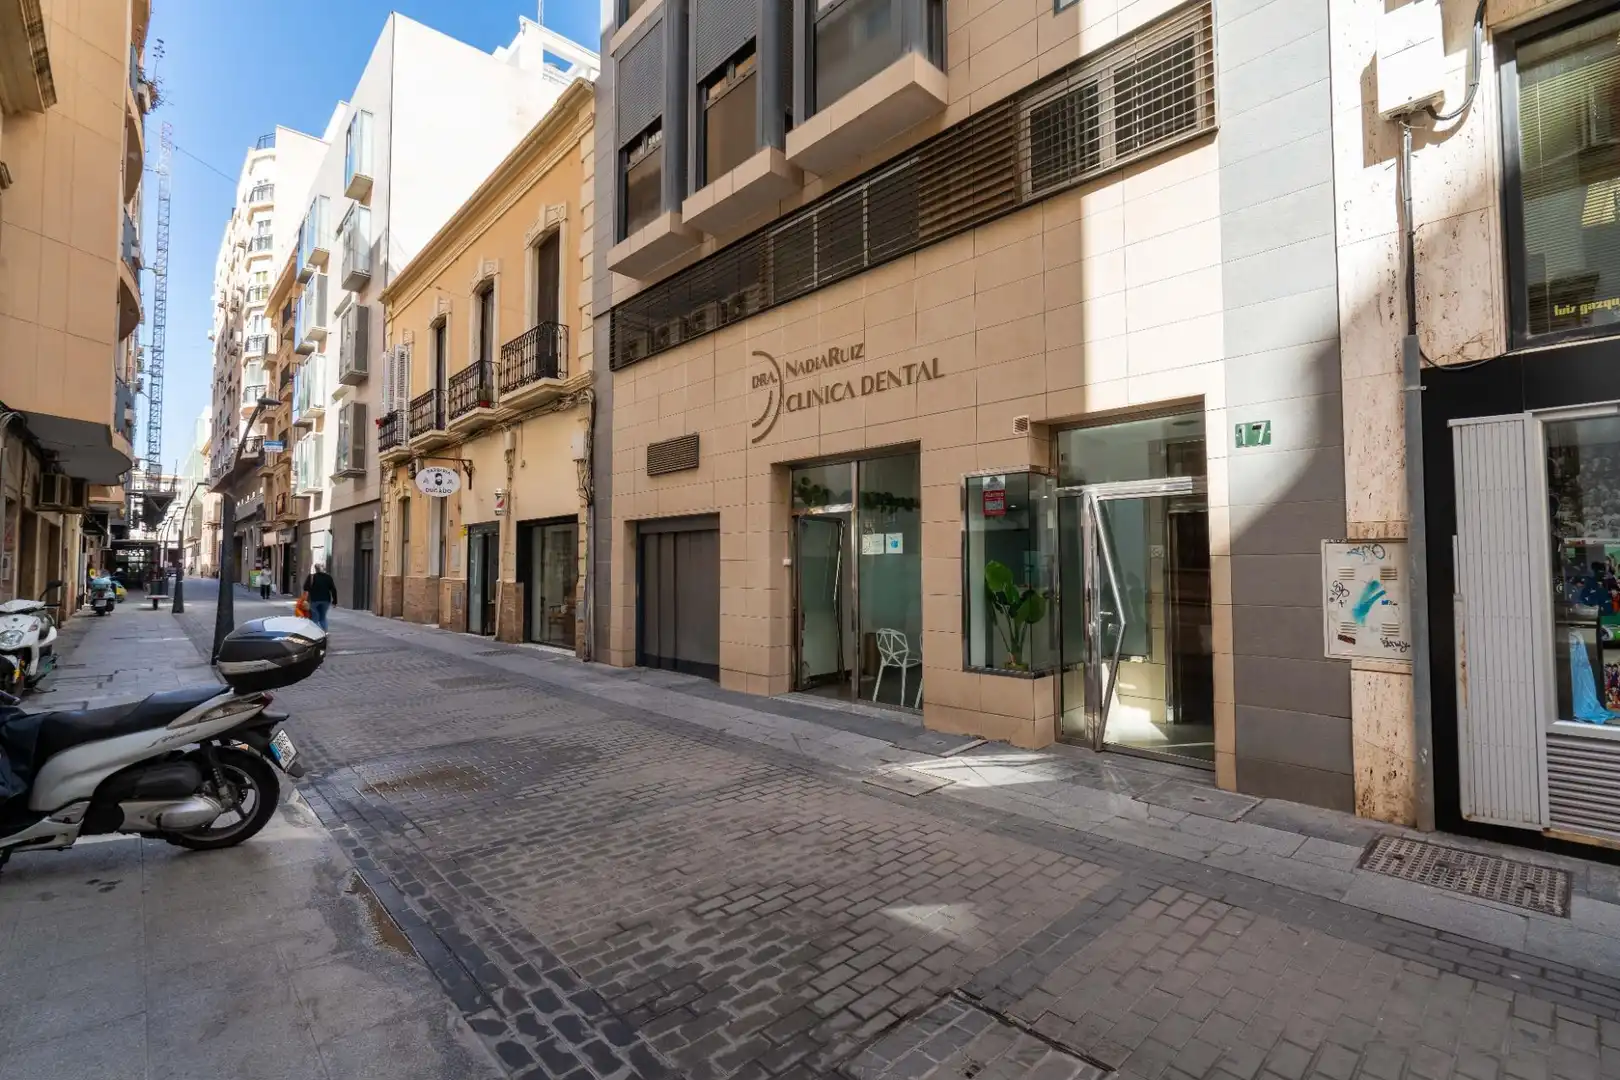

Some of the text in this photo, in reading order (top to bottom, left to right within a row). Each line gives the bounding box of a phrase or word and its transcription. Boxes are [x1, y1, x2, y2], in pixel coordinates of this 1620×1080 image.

[786, 357, 945, 413] CLINICA DENTAL
[1239, 423, 1266, 445] 17
